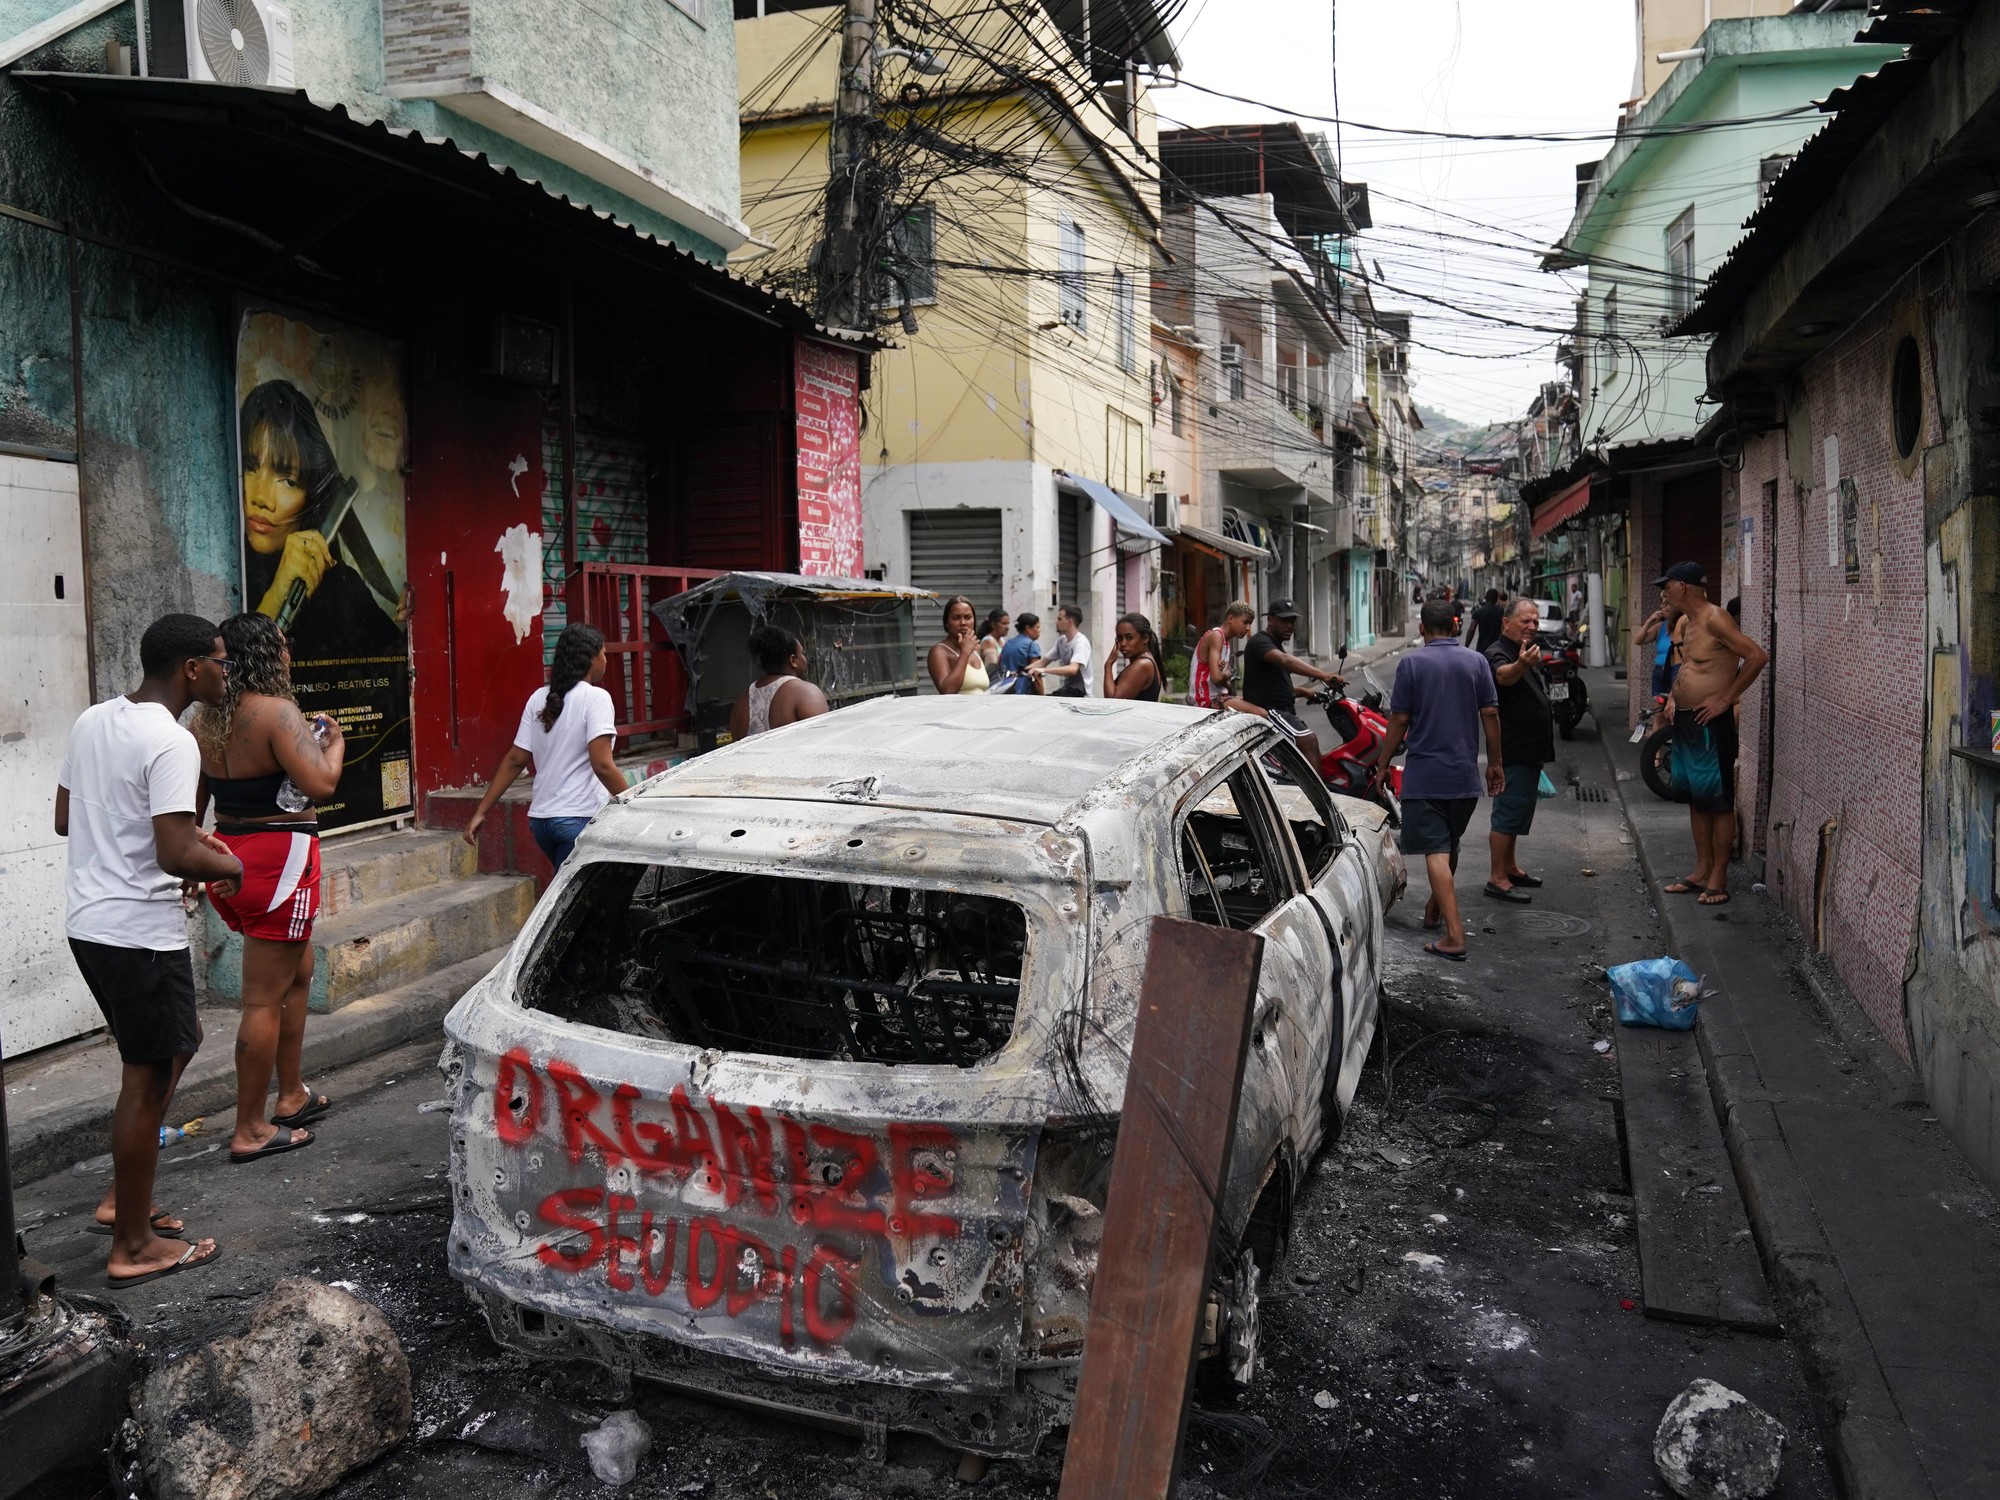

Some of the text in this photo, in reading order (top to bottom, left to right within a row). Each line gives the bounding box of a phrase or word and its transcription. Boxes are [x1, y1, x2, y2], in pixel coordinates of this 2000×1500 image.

[367, 656, 406, 664] PERSONALIZADO
[337, 679, 371, 690] REATIVE
[373, 678, 389, 687] LISS
[338, 705, 372, 715] INTENSIVOS
[337, 713, 383, 723] PERSONALIZADO
[341, 724, 353, 732] CHA
[494, 1046, 961, 1241] ORGANIZE
